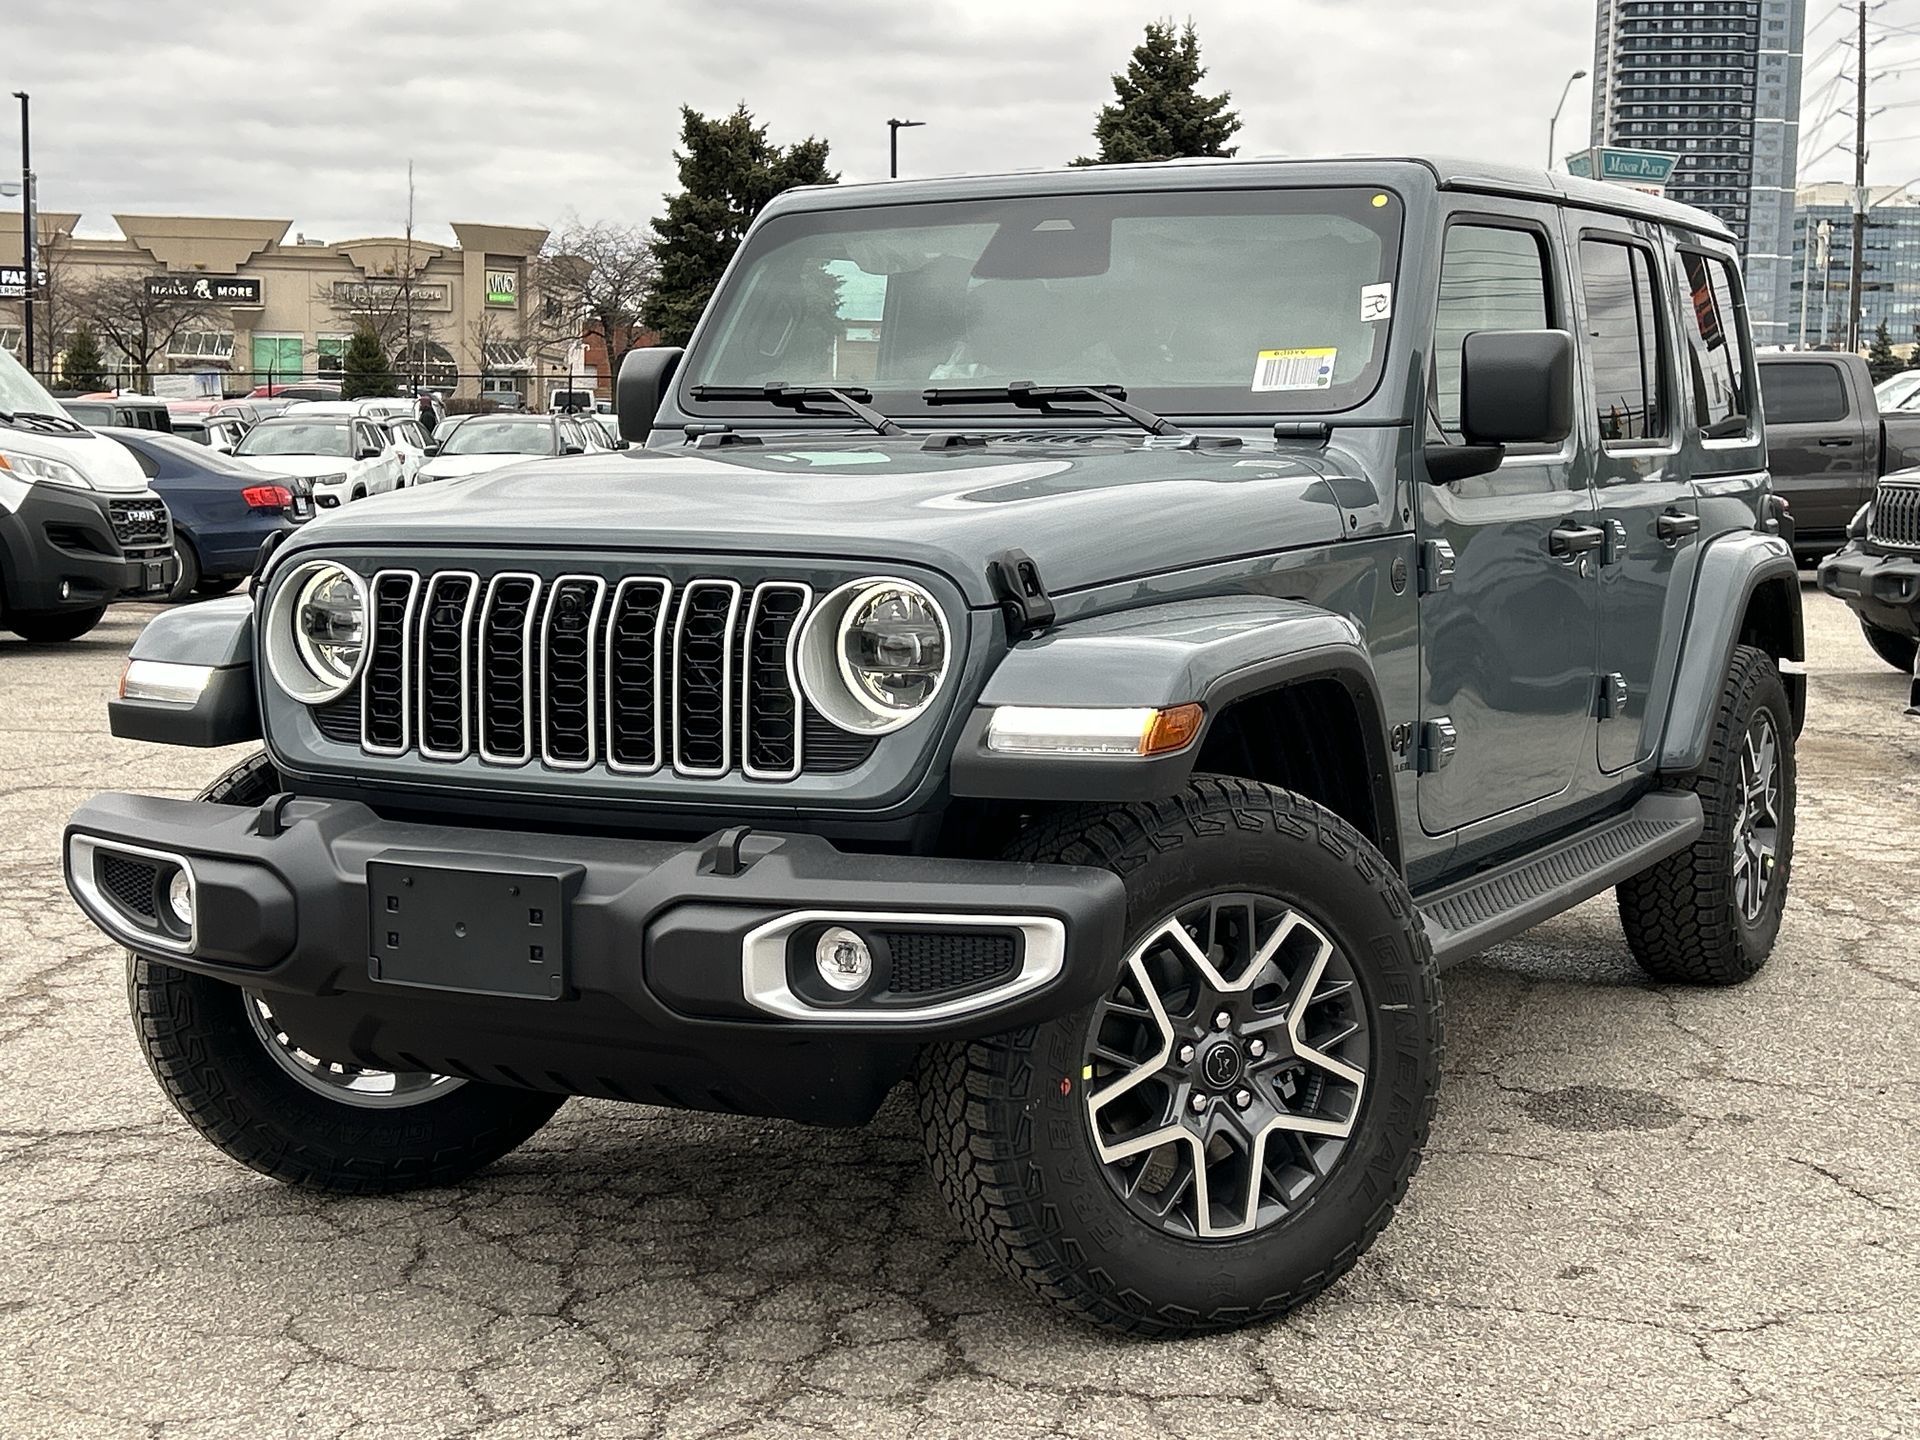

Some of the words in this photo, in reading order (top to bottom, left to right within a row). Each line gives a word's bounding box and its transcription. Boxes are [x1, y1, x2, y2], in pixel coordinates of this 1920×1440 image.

[1, 270, 47, 285] FADS
[217, 286, 253, 297] MORE
[1349, 934, 1420, 1203] GENERAL
